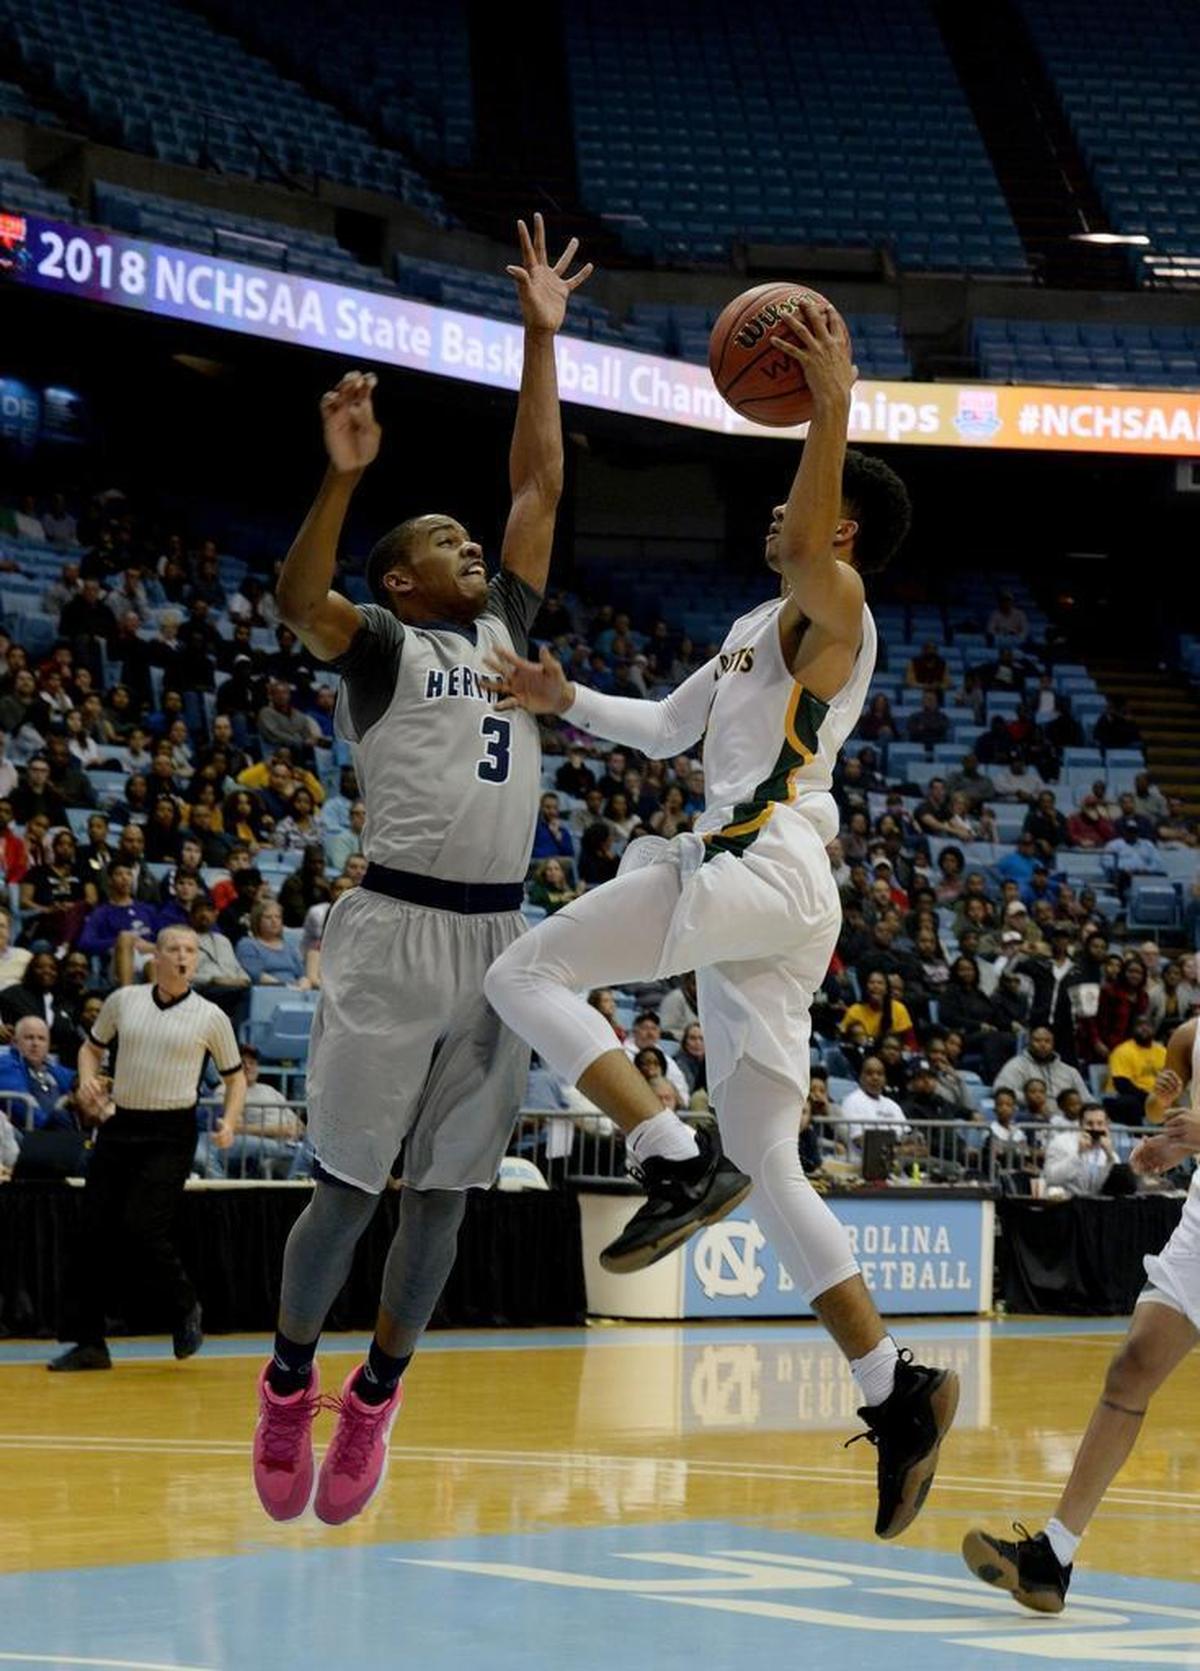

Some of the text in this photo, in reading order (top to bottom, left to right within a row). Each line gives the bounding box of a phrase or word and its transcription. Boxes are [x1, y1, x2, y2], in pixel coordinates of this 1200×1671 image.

[37, 231, 146, 295] 2018
[155, 255, 326, 337] NCHSAA
[335, 297, 432, 357] State
[441, 320, 622, 399] Baskball
[1018, 404, 1200, 442] #NCHSAA
[477, 715, 511, 785] 3
[845, 1225, 951, 1254] ROLINA
